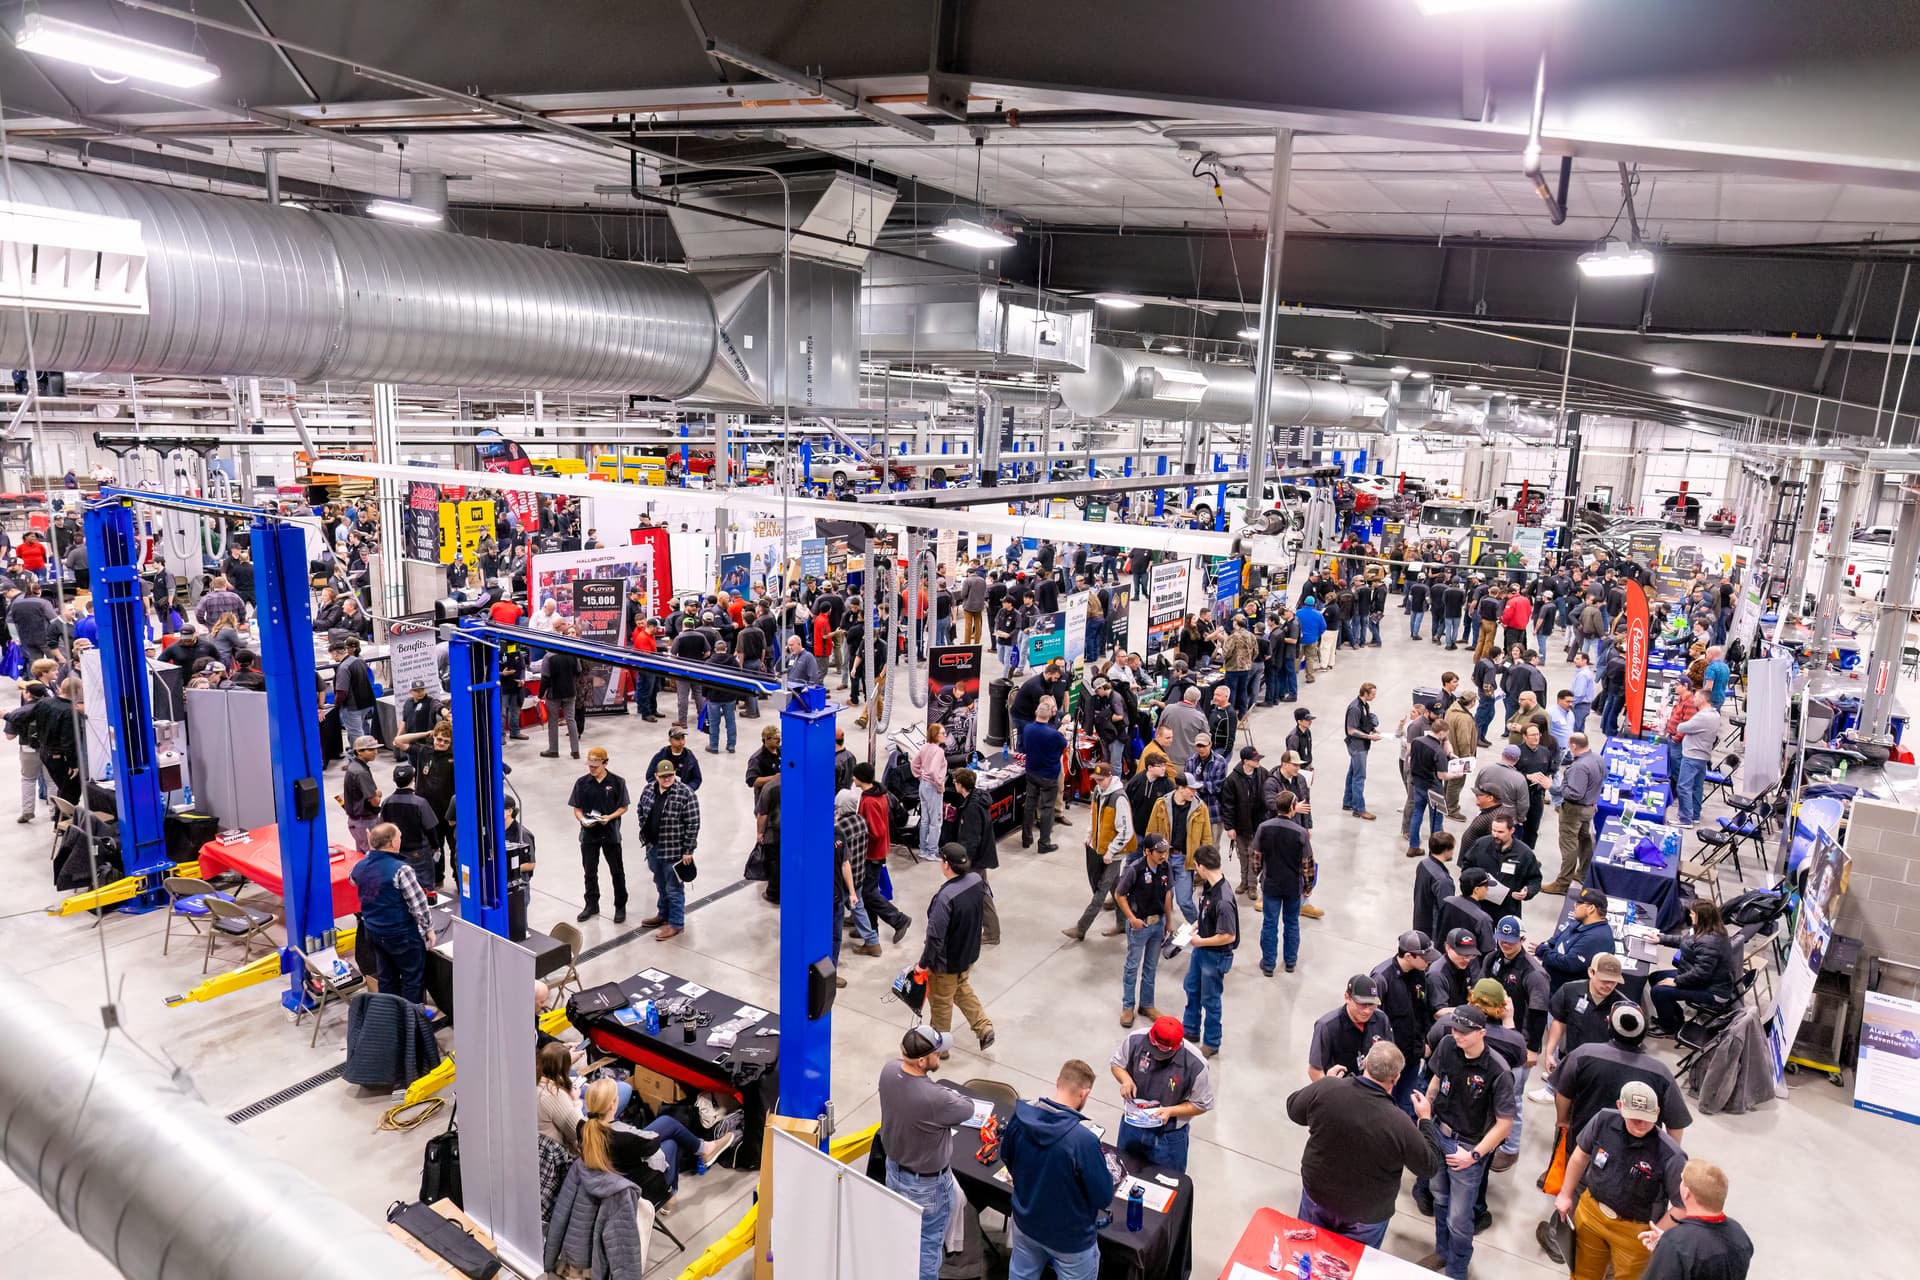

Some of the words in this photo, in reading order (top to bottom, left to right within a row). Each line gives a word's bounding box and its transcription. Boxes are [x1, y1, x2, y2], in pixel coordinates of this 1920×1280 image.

[576, 555, 615, 564] HALLIBURTON
[582, 595, 615, 605] $15,000
[1632, 627, 1643, 683] Peterbilt
[1868, 1035, 1906, 1048] Adventure
